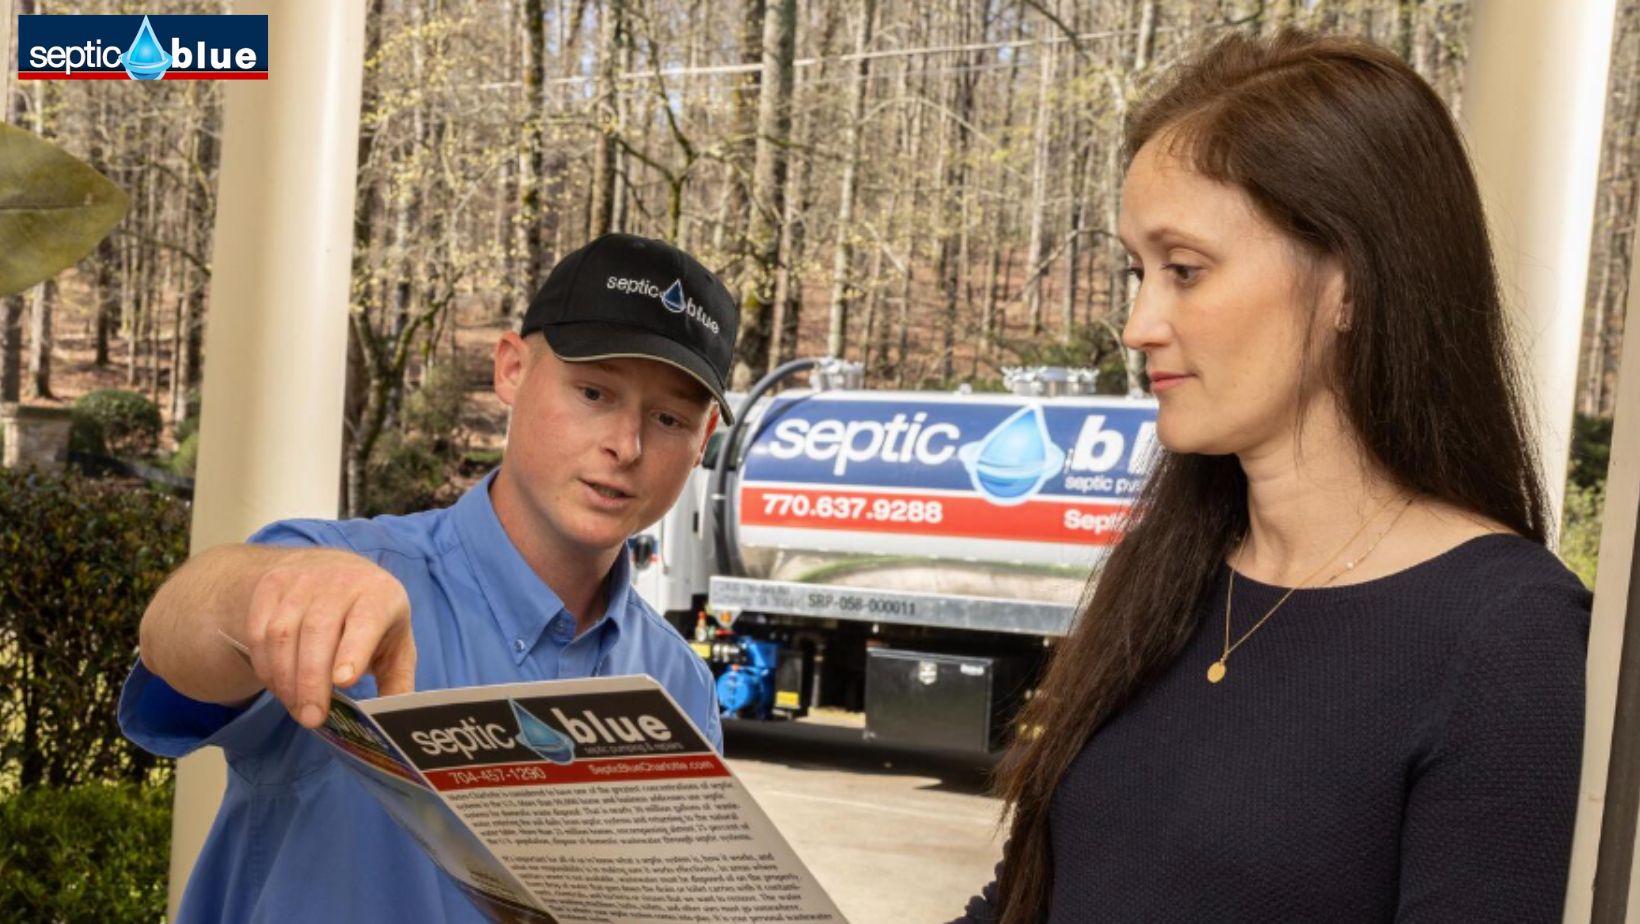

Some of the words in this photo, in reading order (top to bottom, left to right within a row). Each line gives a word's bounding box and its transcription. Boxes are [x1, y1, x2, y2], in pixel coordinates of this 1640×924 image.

[606, 276, 659, 298] septic
[686, 297, 719, 334] blue
[769, 411, 960, 476] septic
[1070, 414, 1158, 475] bl
[1064, 475, 1113, 494] septic
[762, 493, 943, 525] 770.637.9288
[411, 717, 517, 759] septic
[550, 707, 672, 744] blue
[448, 765, 547, 785] 704-457-1290
[588, 761, 715, 776] SepticBlueCharlotte.com
